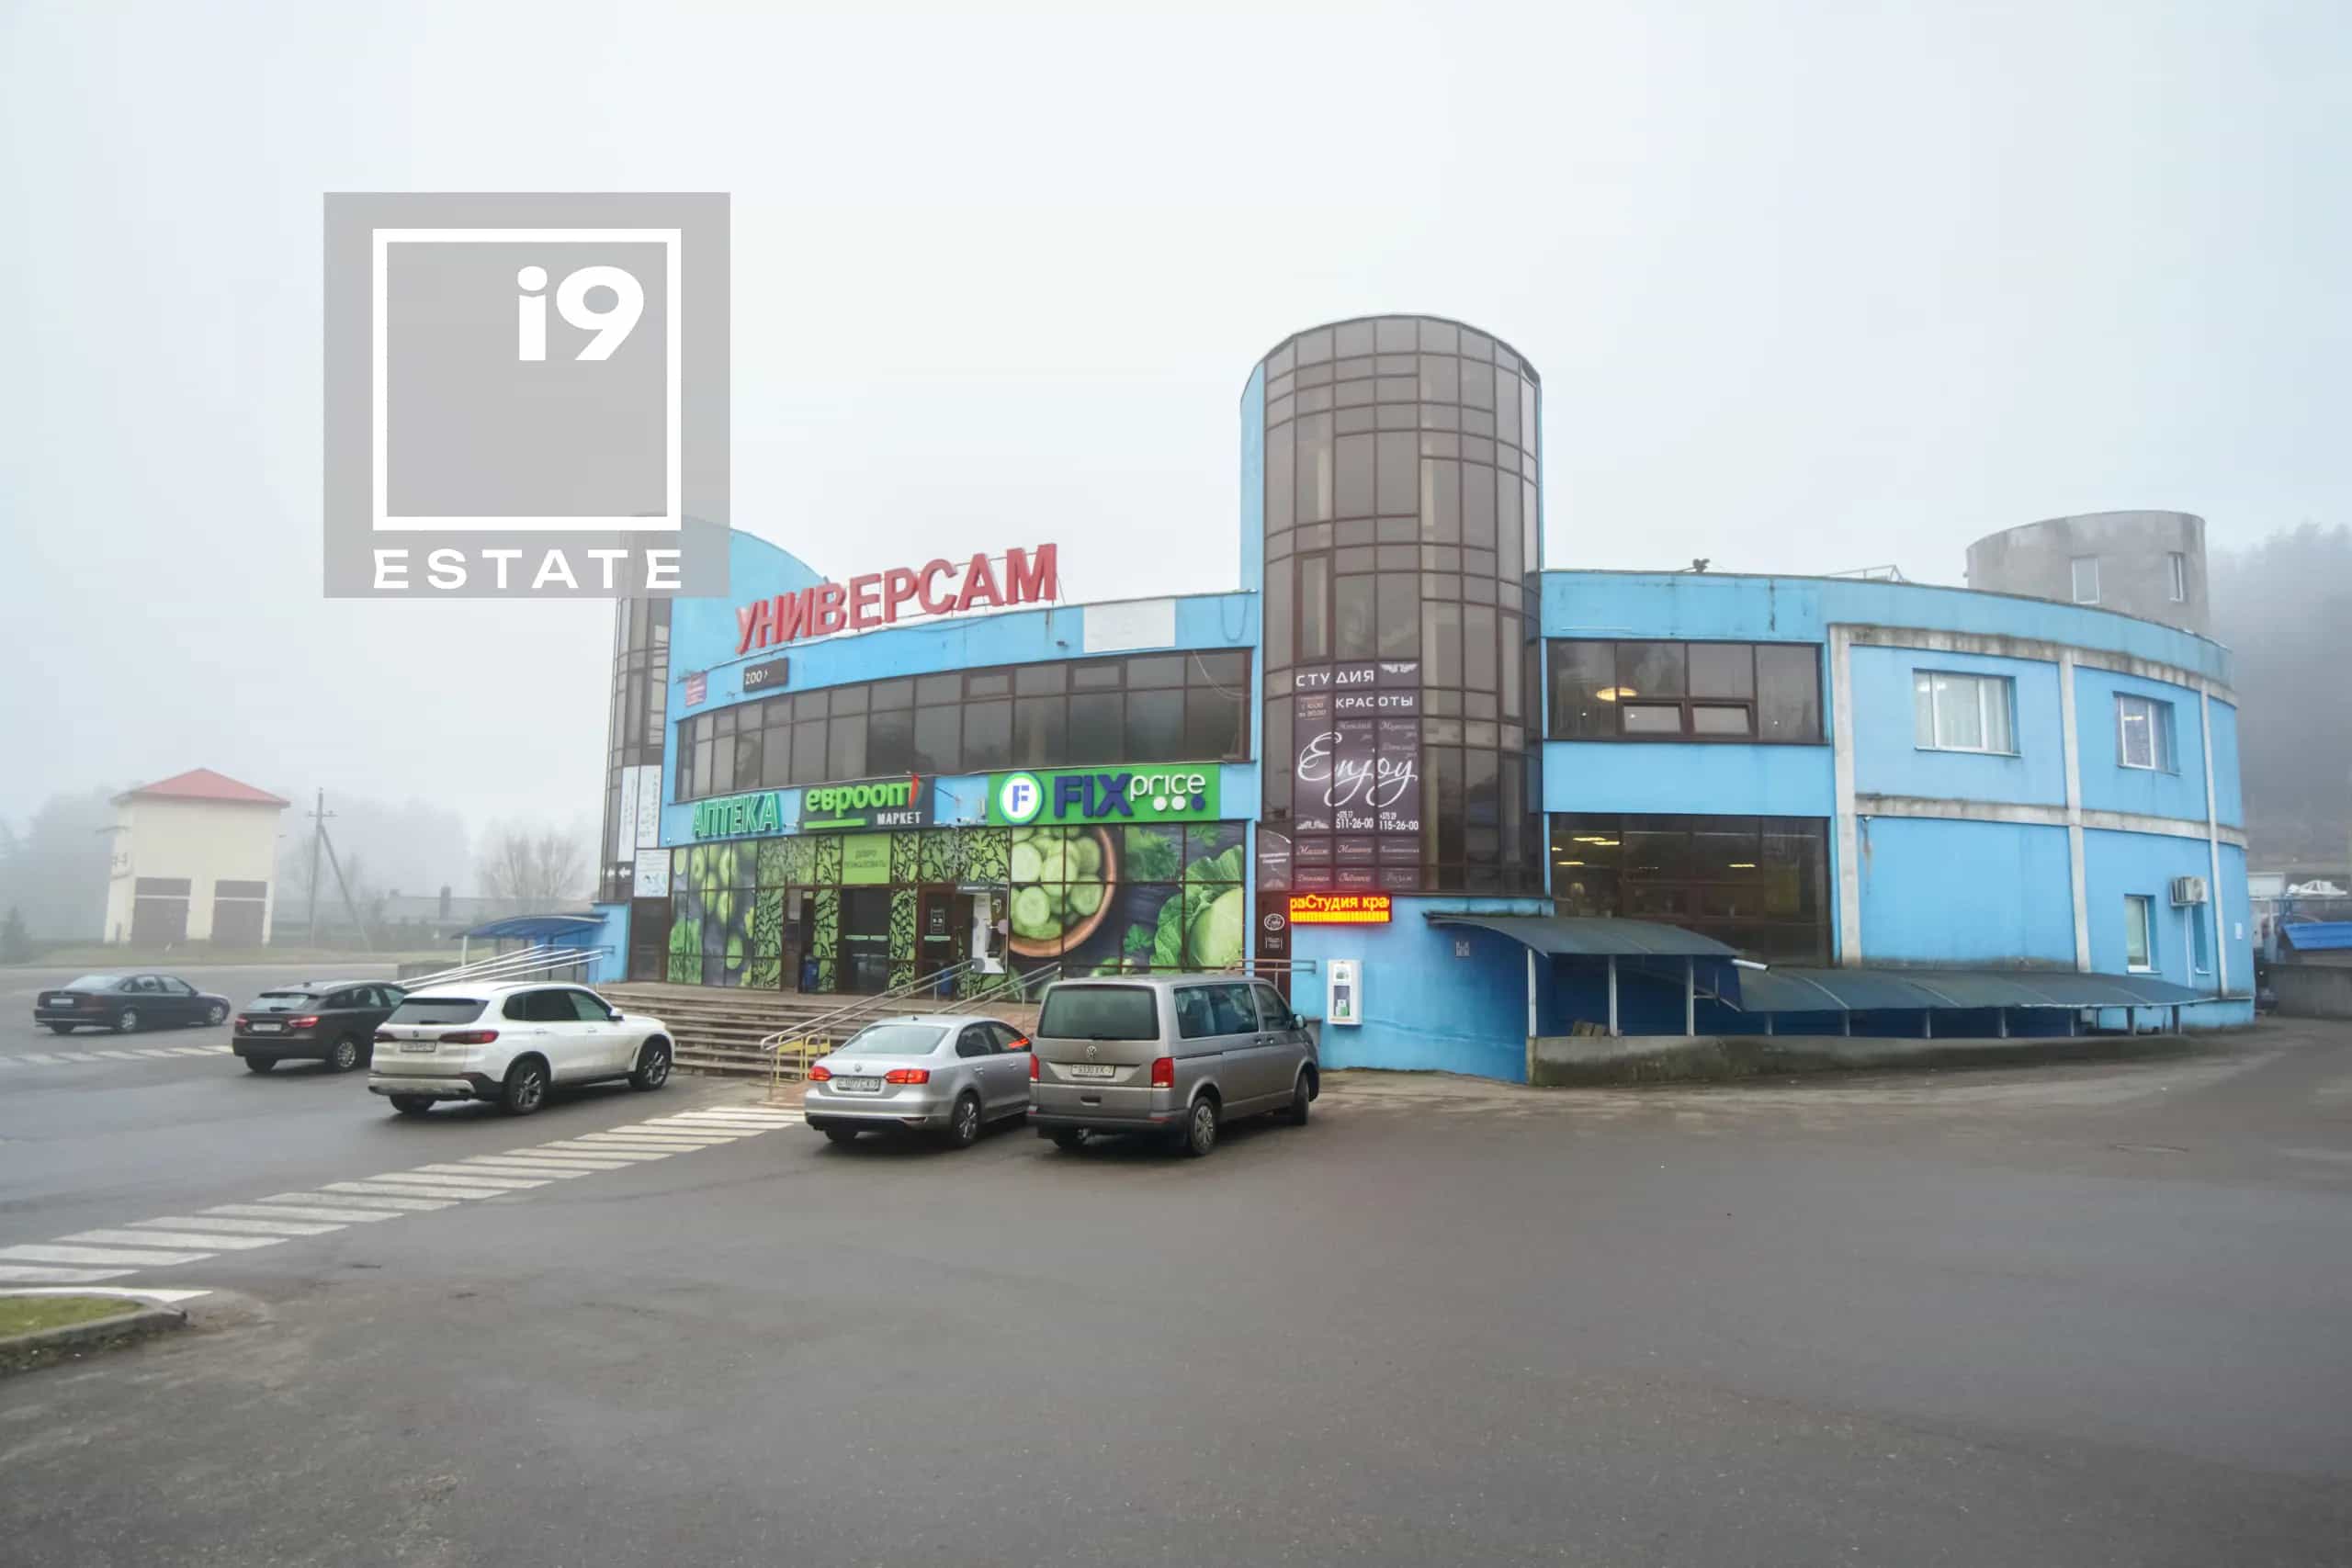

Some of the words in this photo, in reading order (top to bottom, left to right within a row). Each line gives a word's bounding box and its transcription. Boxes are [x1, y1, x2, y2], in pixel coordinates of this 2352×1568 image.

[735, 543, 1057, 655] УНИВЕРСАМ
[1295, 670, 1374, 687] СТУДИЯ
[1335, 696, 1414, 709] КРАСОТЫ
[1297, 731, 1419, 808] Enjoy
[1130, 773, 1205, 801] price
[693, 791, 781, 840] АПТЕКА
[876, 811, 922, 826] МАРКЕТ
[1380, 820, 1419, 830] 115-26-00
